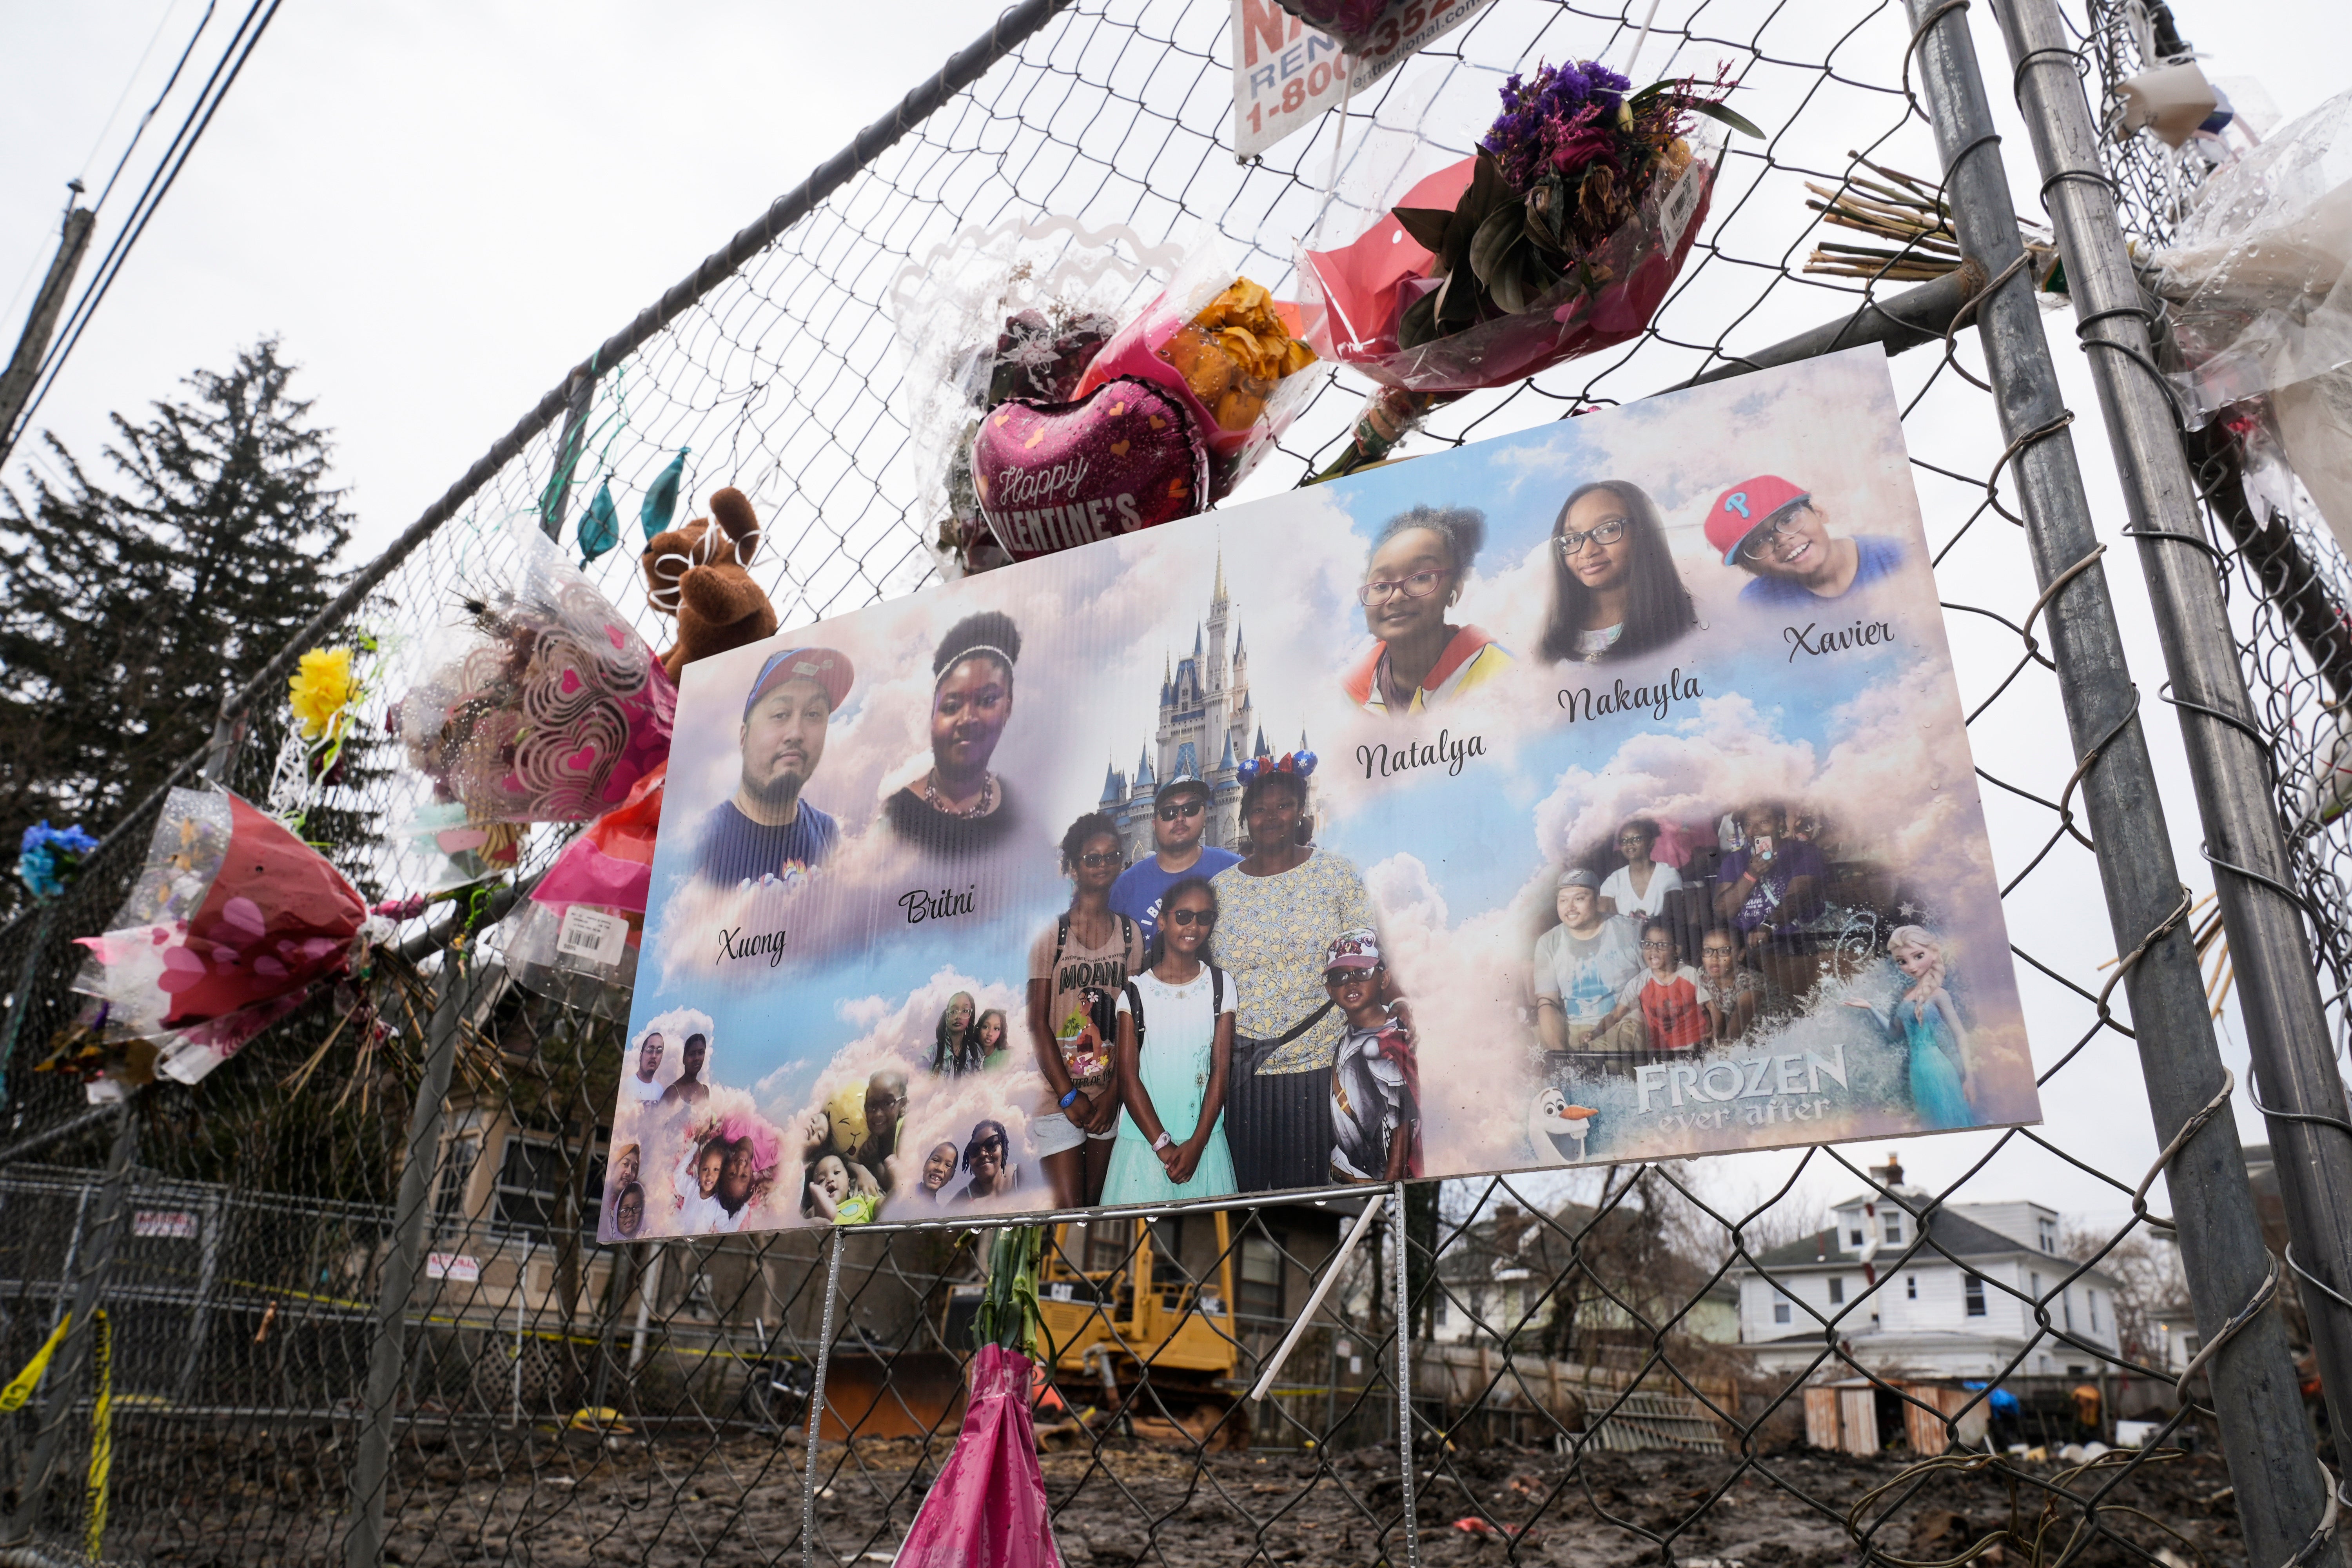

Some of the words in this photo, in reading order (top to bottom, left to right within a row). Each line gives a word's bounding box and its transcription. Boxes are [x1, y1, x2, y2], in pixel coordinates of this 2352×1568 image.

[1351, 0, 1481, 88] entnational.com
[999, 456, 1089, 505] Happy
[985, 492, 1142, 552] VALENTINE'S
[1724, 491, 1749, 519] P
[1783, 620, 1895, 663] Xavier
[1557, 667, 1704, 723] Nakayla
[1356, 729, 1486, 779] Natalya
[898, 884, 975, 924] Britni
[716, 926, 787, 967] Xuong
[1059, 961, 1126, 995] MOANA
[1633, 1043, 1849, 1115] FROZEN
[1658, 1107, 1730, 1134] ever
[1745, 1098, 1832, 1127] after
